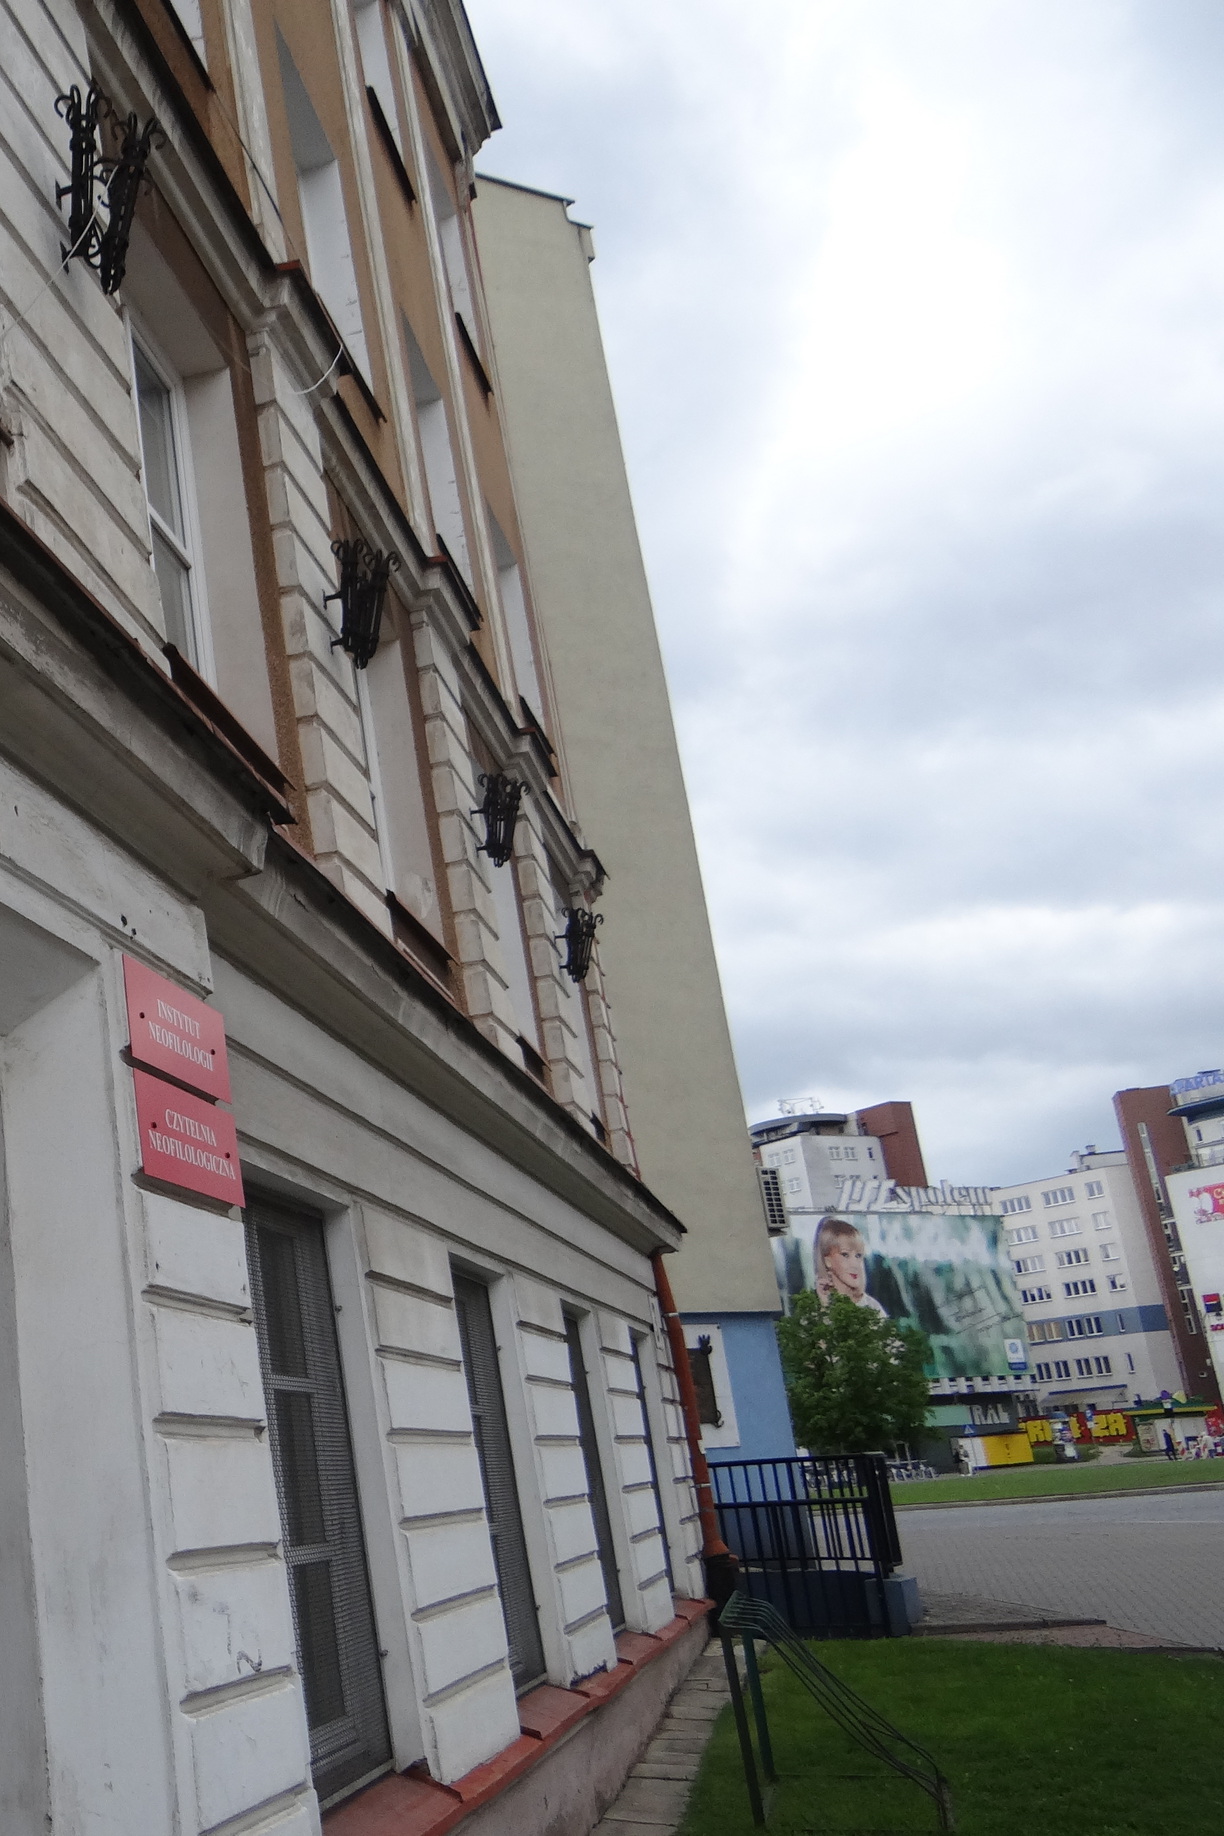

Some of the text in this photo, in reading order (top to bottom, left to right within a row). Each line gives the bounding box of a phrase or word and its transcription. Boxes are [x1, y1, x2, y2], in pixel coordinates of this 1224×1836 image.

[156, 998, 201, 1040] INSTYTUT
[148, 1020, 214, 1072] NEOFILOLOGII
[165, 1108, 218, 1148] CZYTELNIA
[148, 1128, 236, 1180] NEOFILOLOGICZNA
